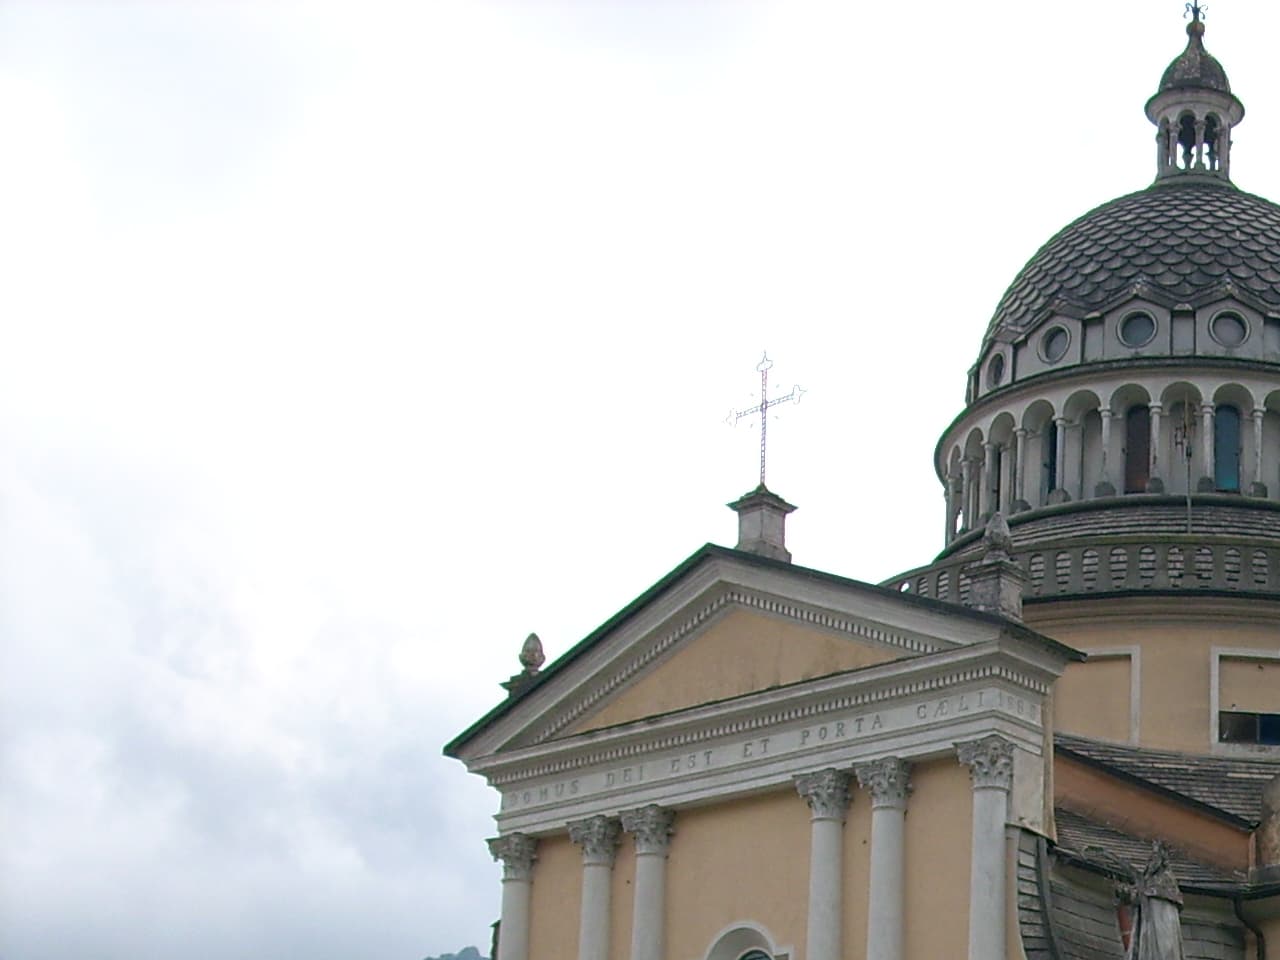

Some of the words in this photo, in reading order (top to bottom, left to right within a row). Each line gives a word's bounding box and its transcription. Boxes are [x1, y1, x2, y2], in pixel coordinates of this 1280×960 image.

[509, 779, 579, 806] DOMUS
[605, 765, 645, 788] DEI
[670, 751, 714, 773] EST
[743, 738, 770, 758] ET
[801, 714, 884, 745] PORTA
